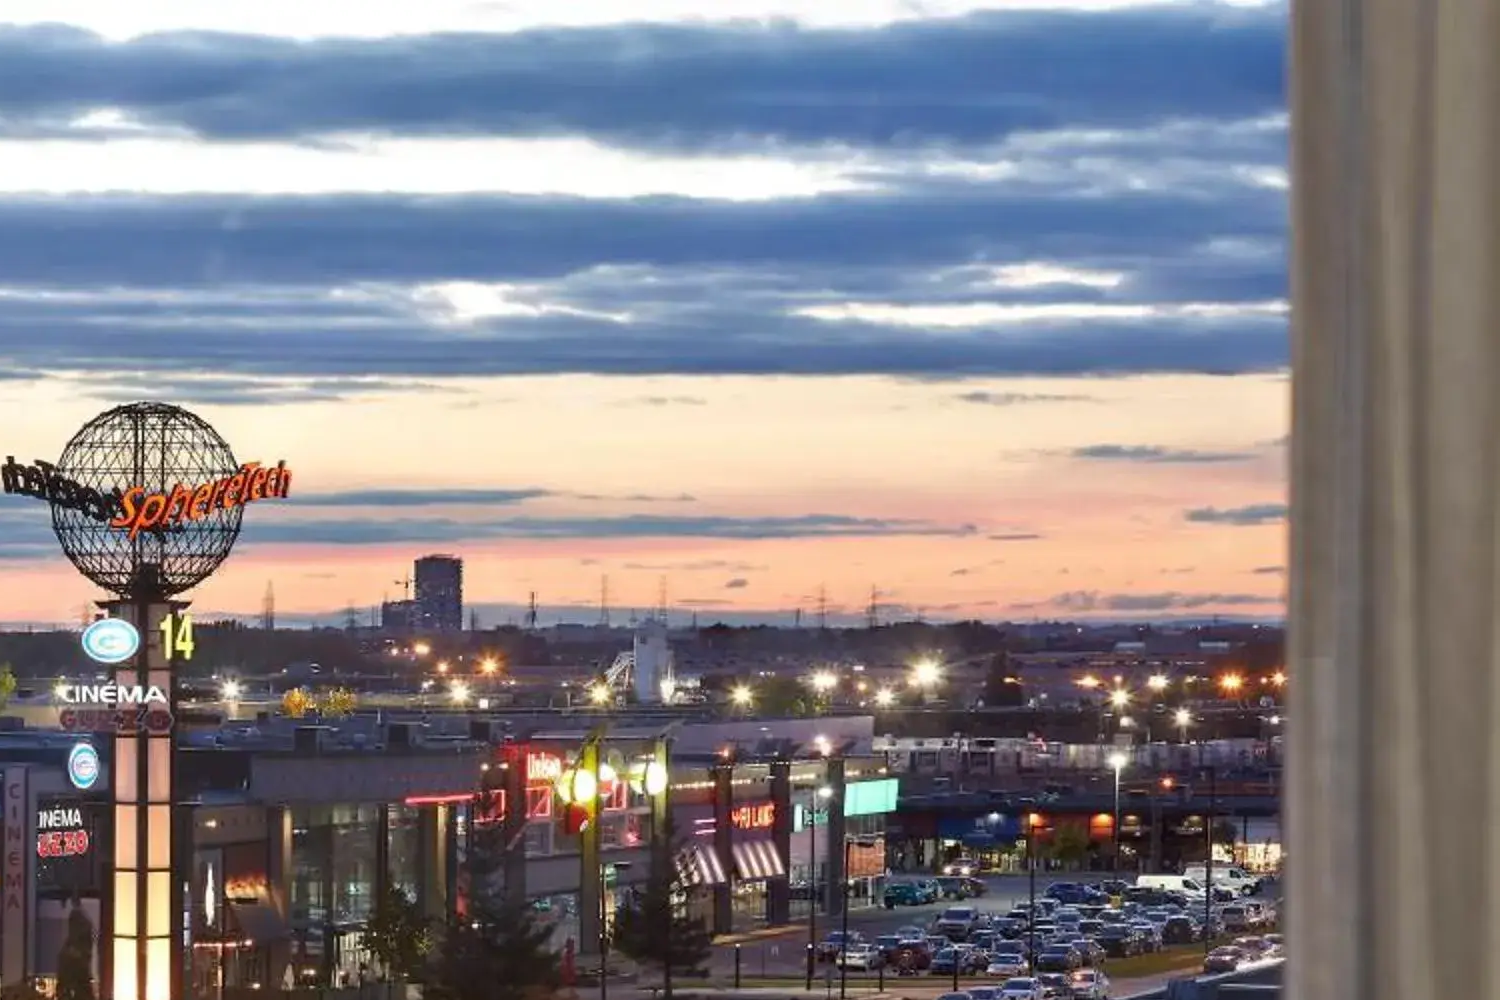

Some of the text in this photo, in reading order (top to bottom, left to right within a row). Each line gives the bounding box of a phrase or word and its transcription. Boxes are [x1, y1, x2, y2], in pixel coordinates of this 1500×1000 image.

[160, 614, 194, 660] 14
[56, 680, 167, 704] CINÉMA
[37, 805, 83, 829] INÉMA
